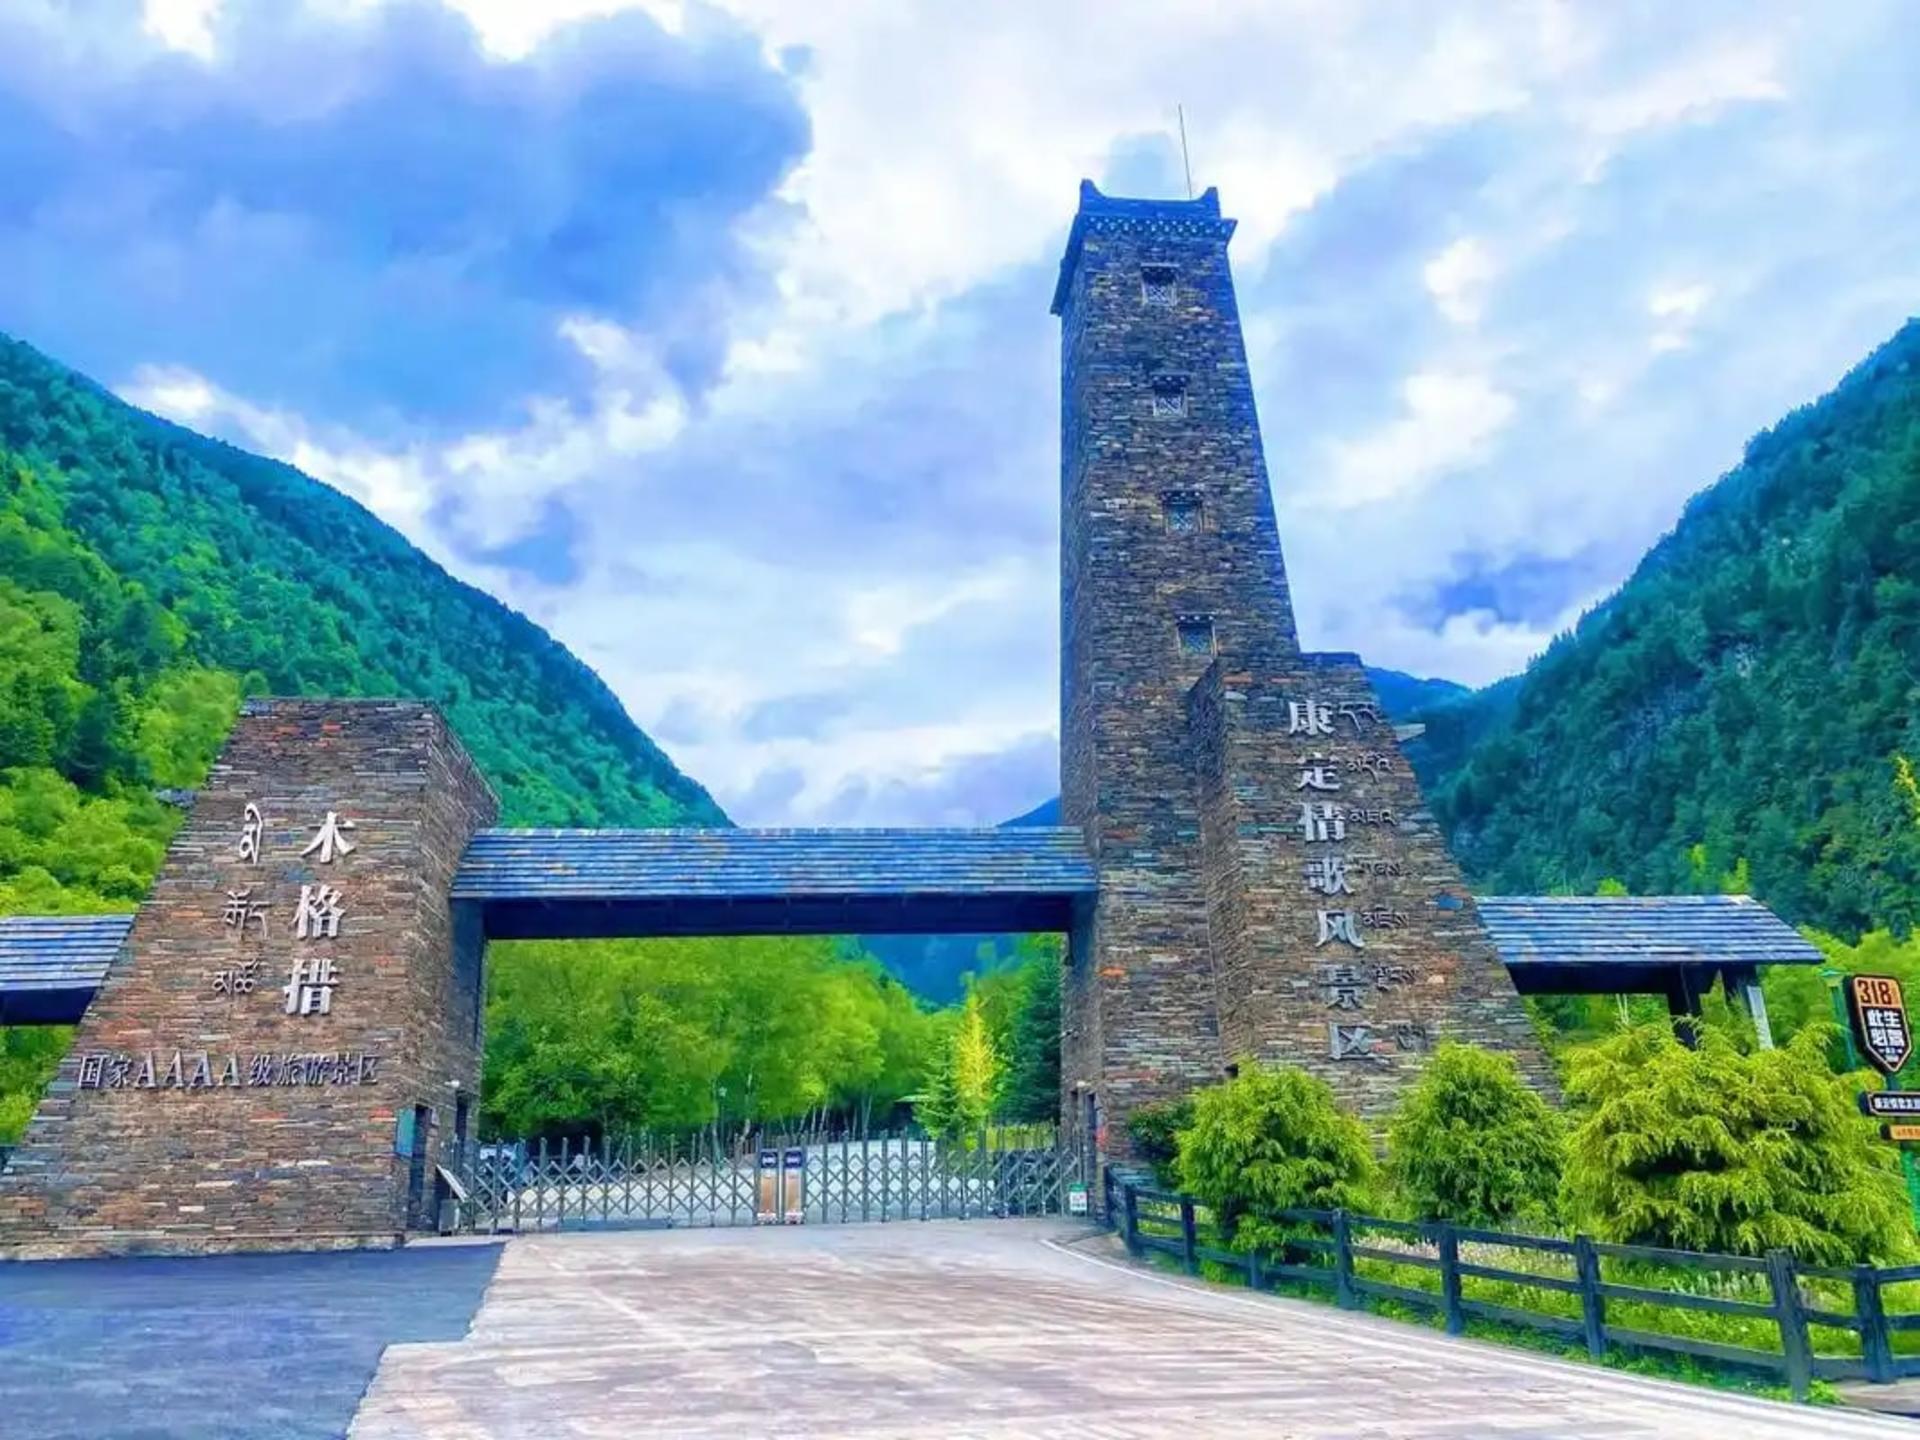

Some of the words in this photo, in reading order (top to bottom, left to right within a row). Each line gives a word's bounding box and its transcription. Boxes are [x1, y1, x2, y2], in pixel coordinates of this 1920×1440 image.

[283, 811, 356, 1014] 木格措
[1289, 700, 1380, 1061] 康定情歌风景区
[1857, 980, 1892, 1005] 318
